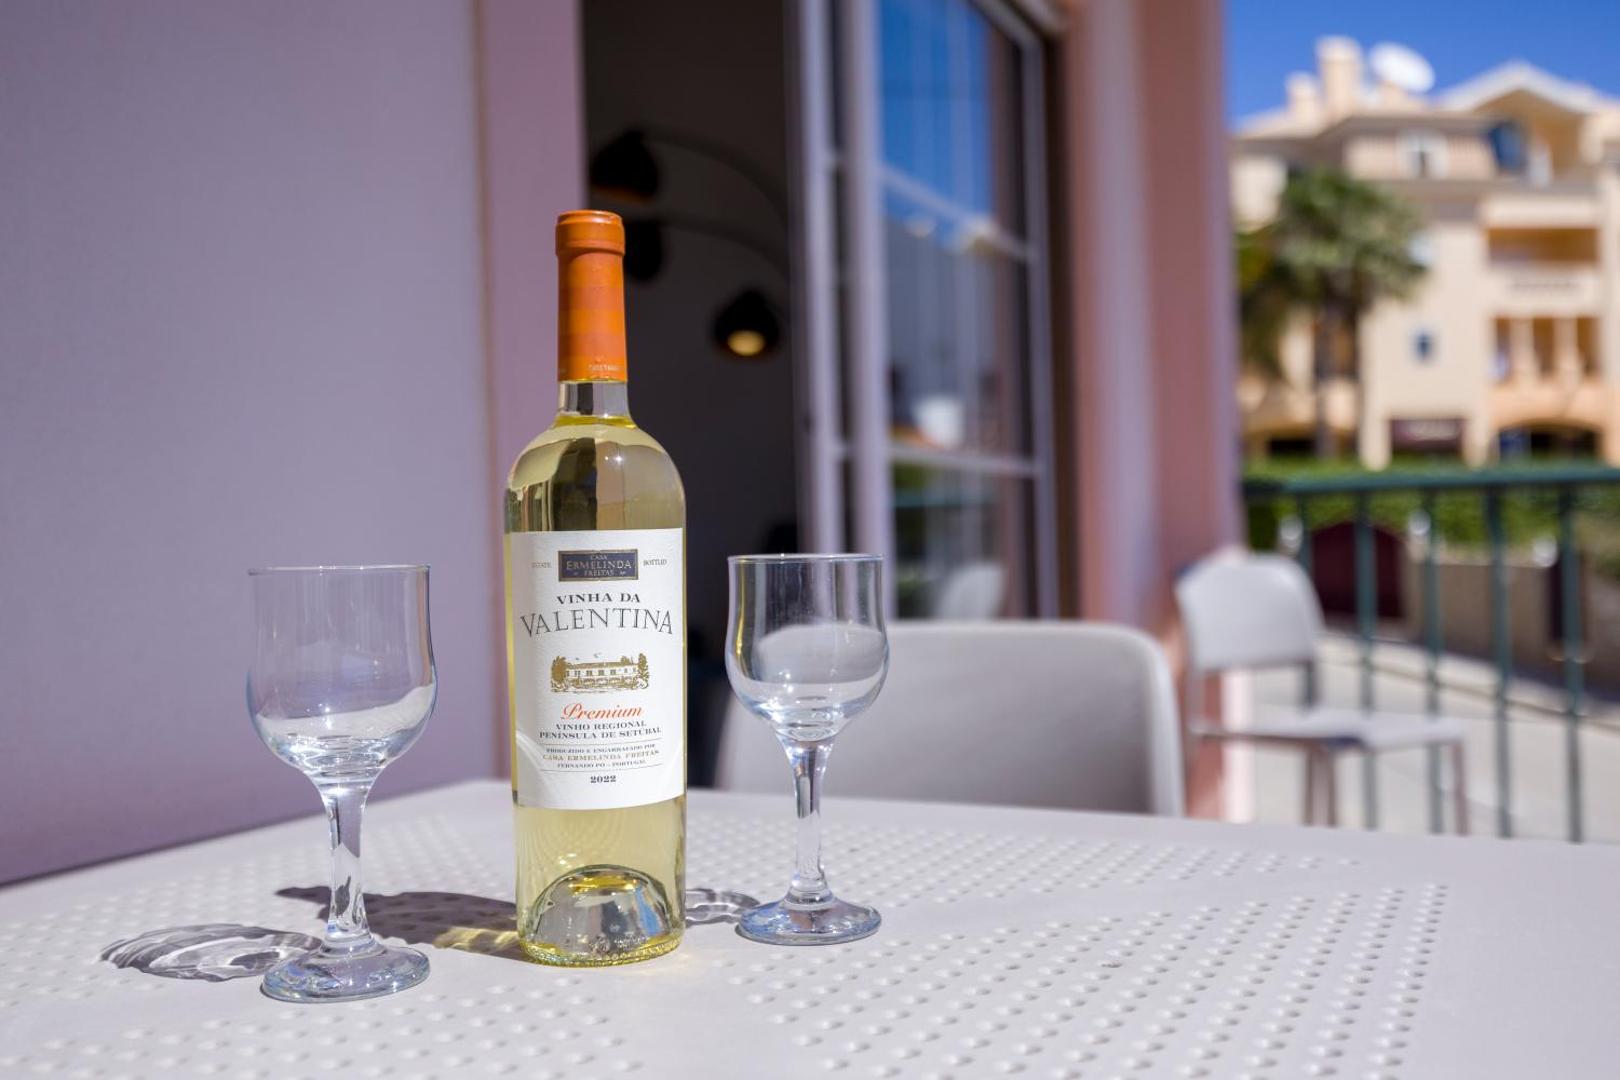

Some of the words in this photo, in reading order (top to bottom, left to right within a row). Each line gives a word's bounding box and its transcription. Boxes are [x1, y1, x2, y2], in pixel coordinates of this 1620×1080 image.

[566, 560, 632, 570] ERMELINDA
[643, 558, 667, 567] BOTTLED
[557, 593, 613, 605] VINHA
[620, 593, 641, 603] DA
[520, 607, 673, 637] VALENTINA
[560, 703, 643, 720] Premium
[556, 723, 591, 731] VINHO
[594, 720, 647, 730] REGIONAL
[601, 731, 617, 739] DE
[567, 753, 621, 761] ERMELINDA
[625, 750, 660, 758] FREITAS
[590, 775, 617, 784] 2022
